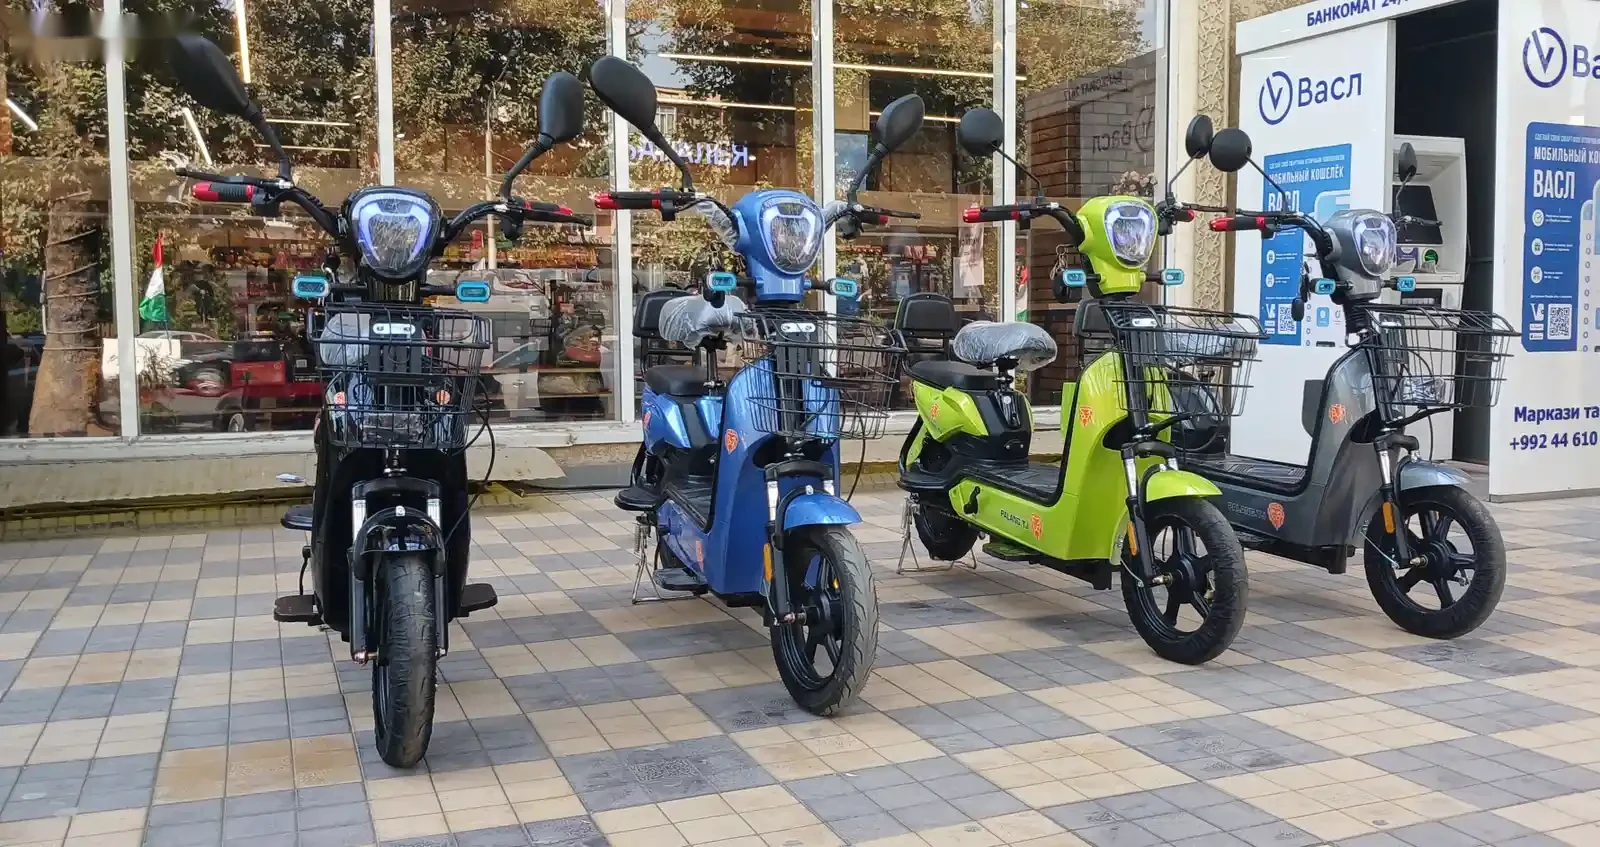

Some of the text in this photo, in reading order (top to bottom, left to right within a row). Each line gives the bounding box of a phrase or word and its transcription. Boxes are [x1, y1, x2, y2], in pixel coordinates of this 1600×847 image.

[1307, 0, 1376, 26] БАНКОМАТ
[1298, 73, 1362, 107] Васл
[1534, 146, 1600, 164] МОБИЛЬНЫЙ КО
[1533, 168, 1576, 199] ВАСЛ
[1514, 406, 1580, 425] Маркази
[1509, 431, 1598, 450] +992 44 610
